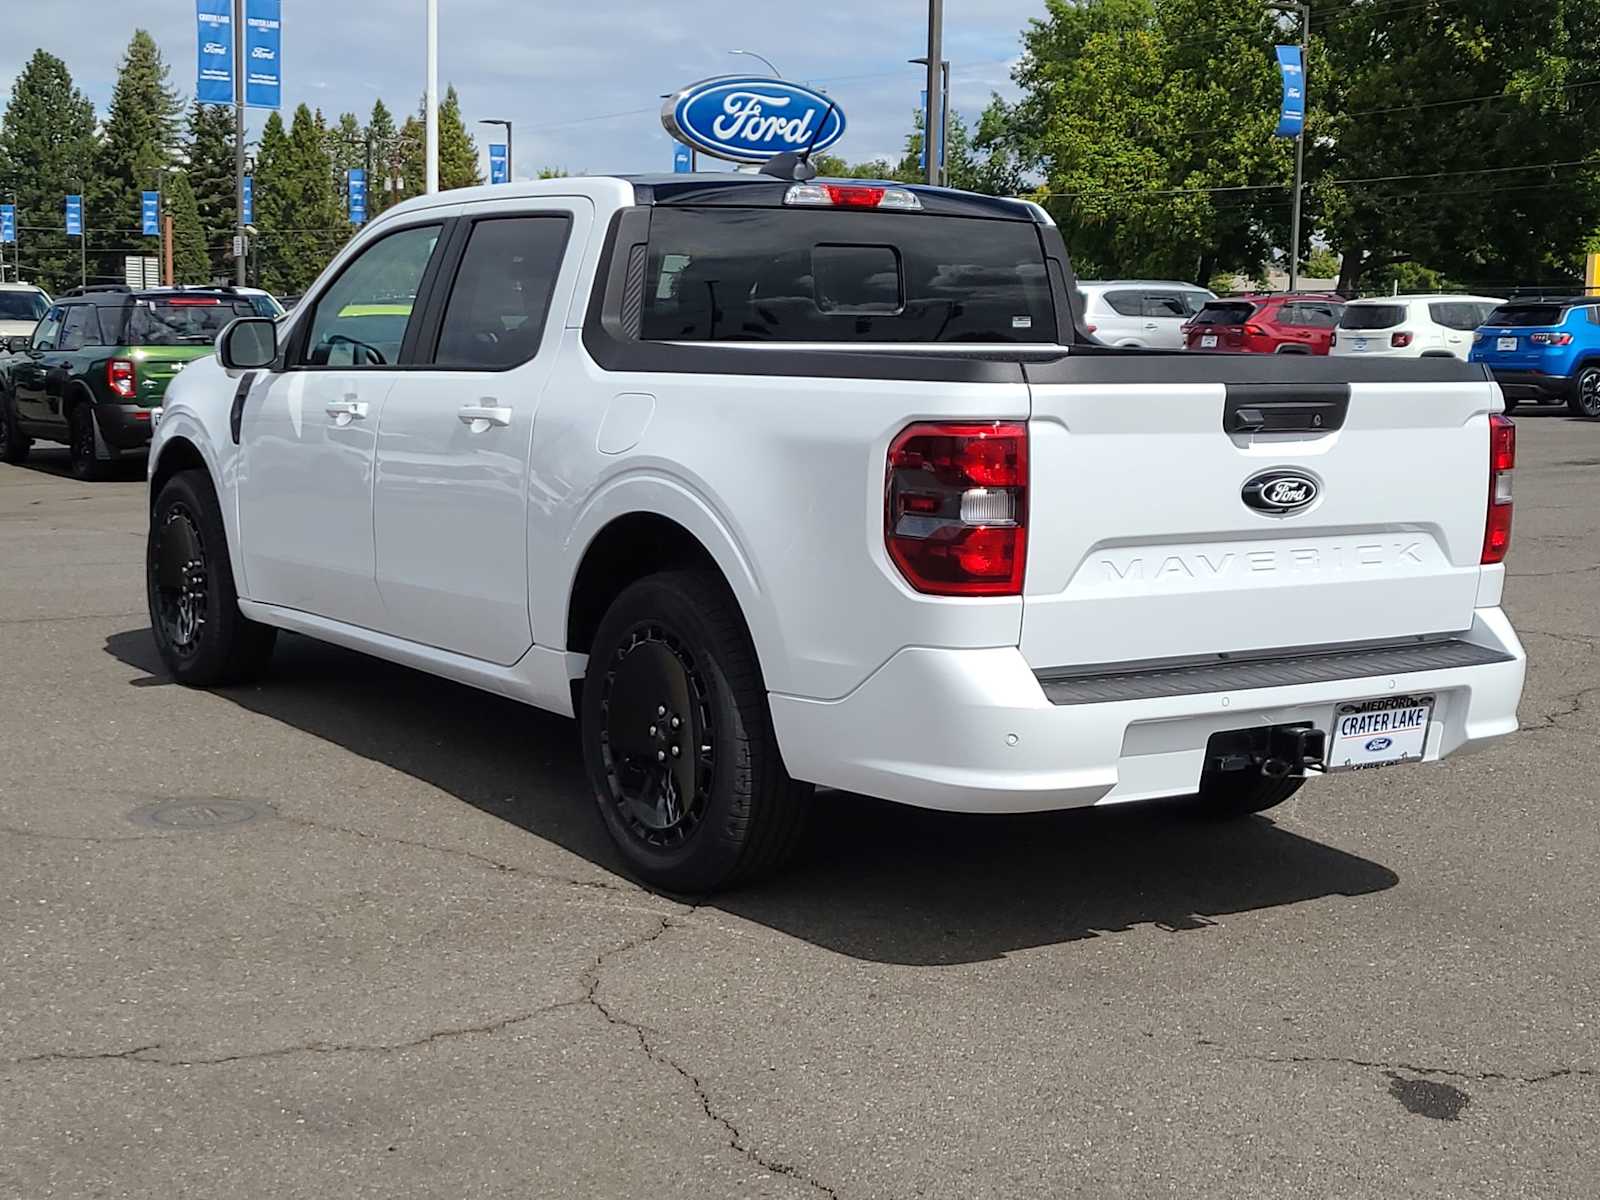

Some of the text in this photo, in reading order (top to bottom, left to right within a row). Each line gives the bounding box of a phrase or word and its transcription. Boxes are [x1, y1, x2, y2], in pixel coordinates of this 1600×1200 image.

[203, 42, 226, 55] Ford
[251, 47, 275, 60] Ford
[713, 92, 815, 143] Ford
[1271, 482, 1307, 502] Ford
[1100, 542, 1423, 581] MAVERICK
[1342, 708, 1424, 735] CRATER LAKE
